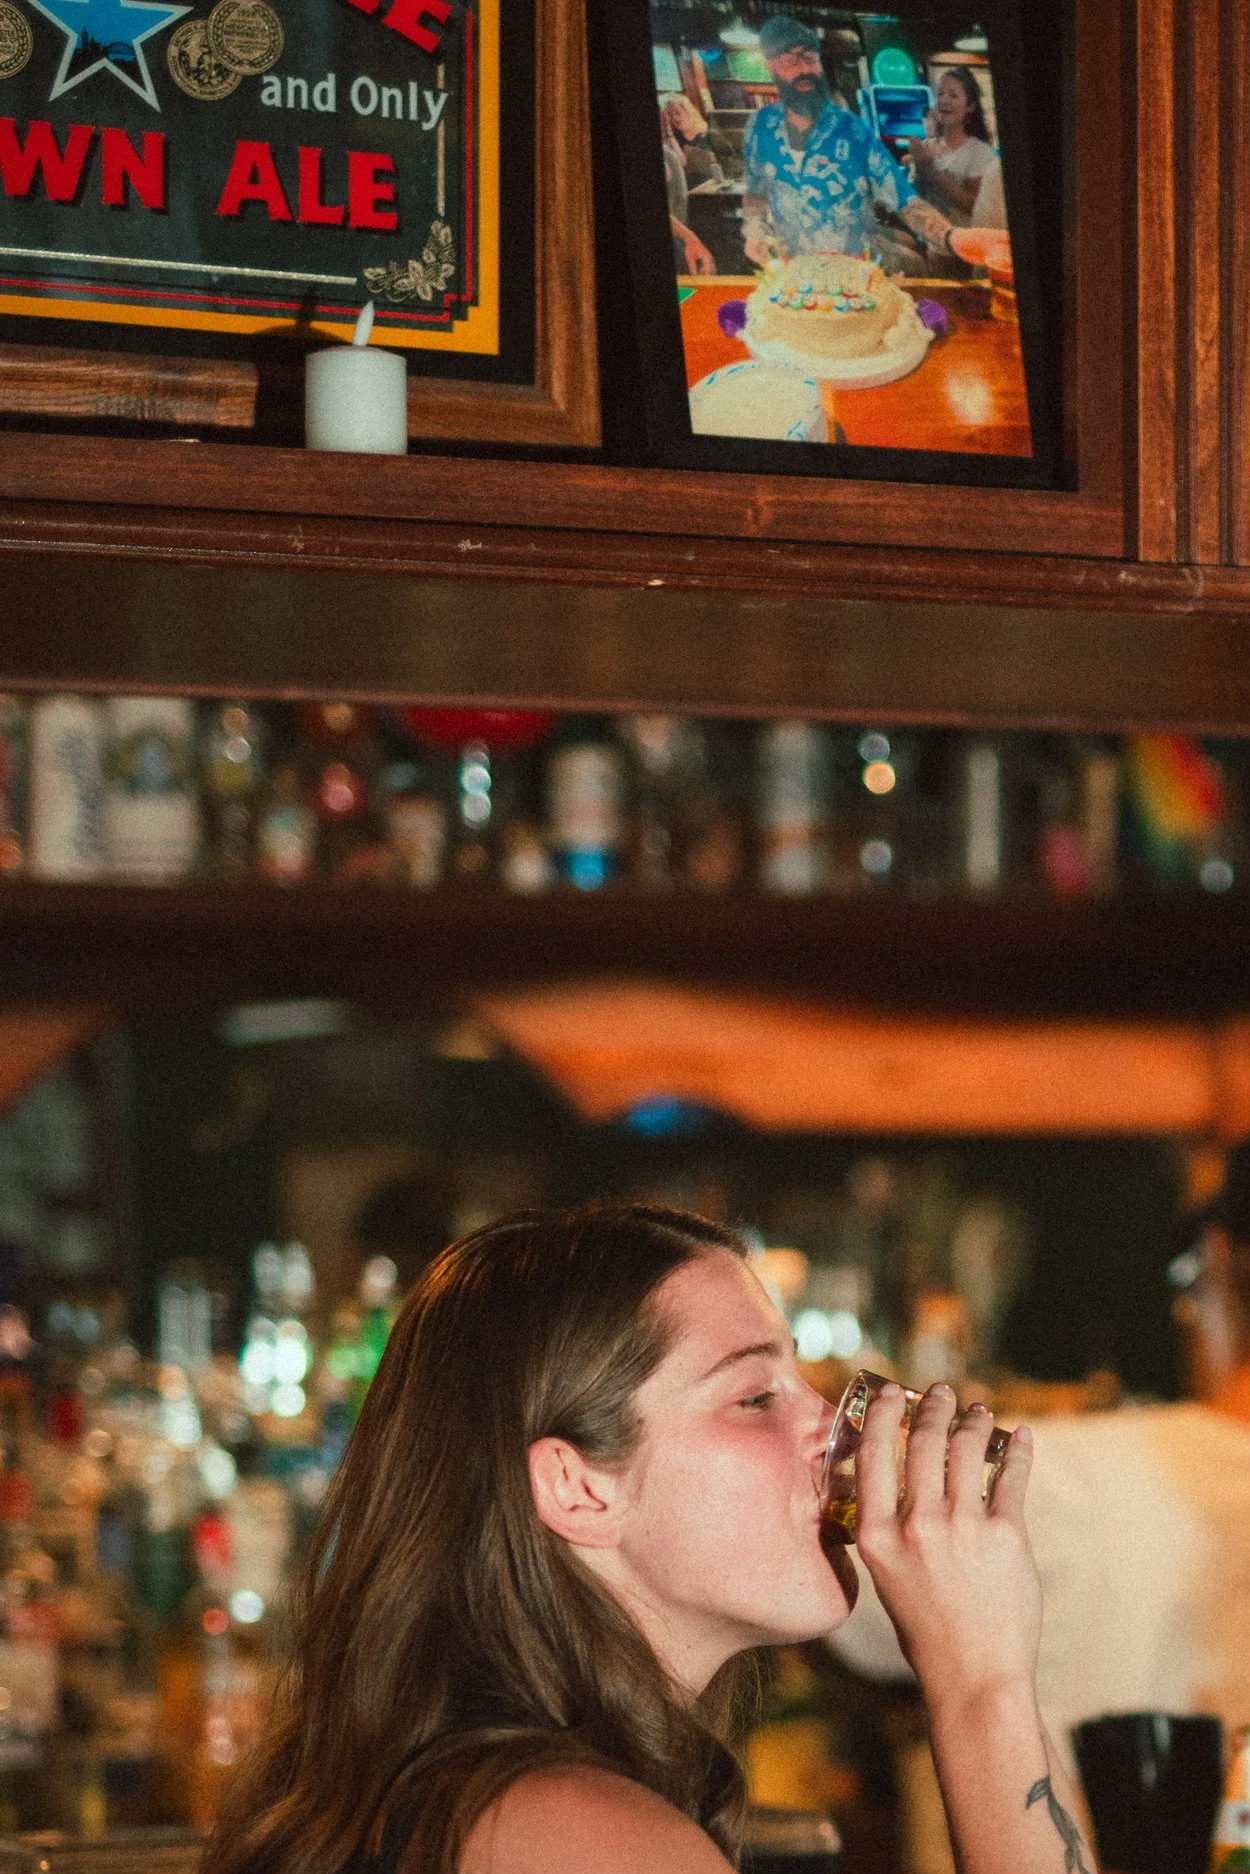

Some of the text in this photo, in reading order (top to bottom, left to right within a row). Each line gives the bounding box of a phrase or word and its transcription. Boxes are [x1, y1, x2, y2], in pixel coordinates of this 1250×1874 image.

[260, 72, 449, 131] and Only
[215, 139, 398, 231] ALE
